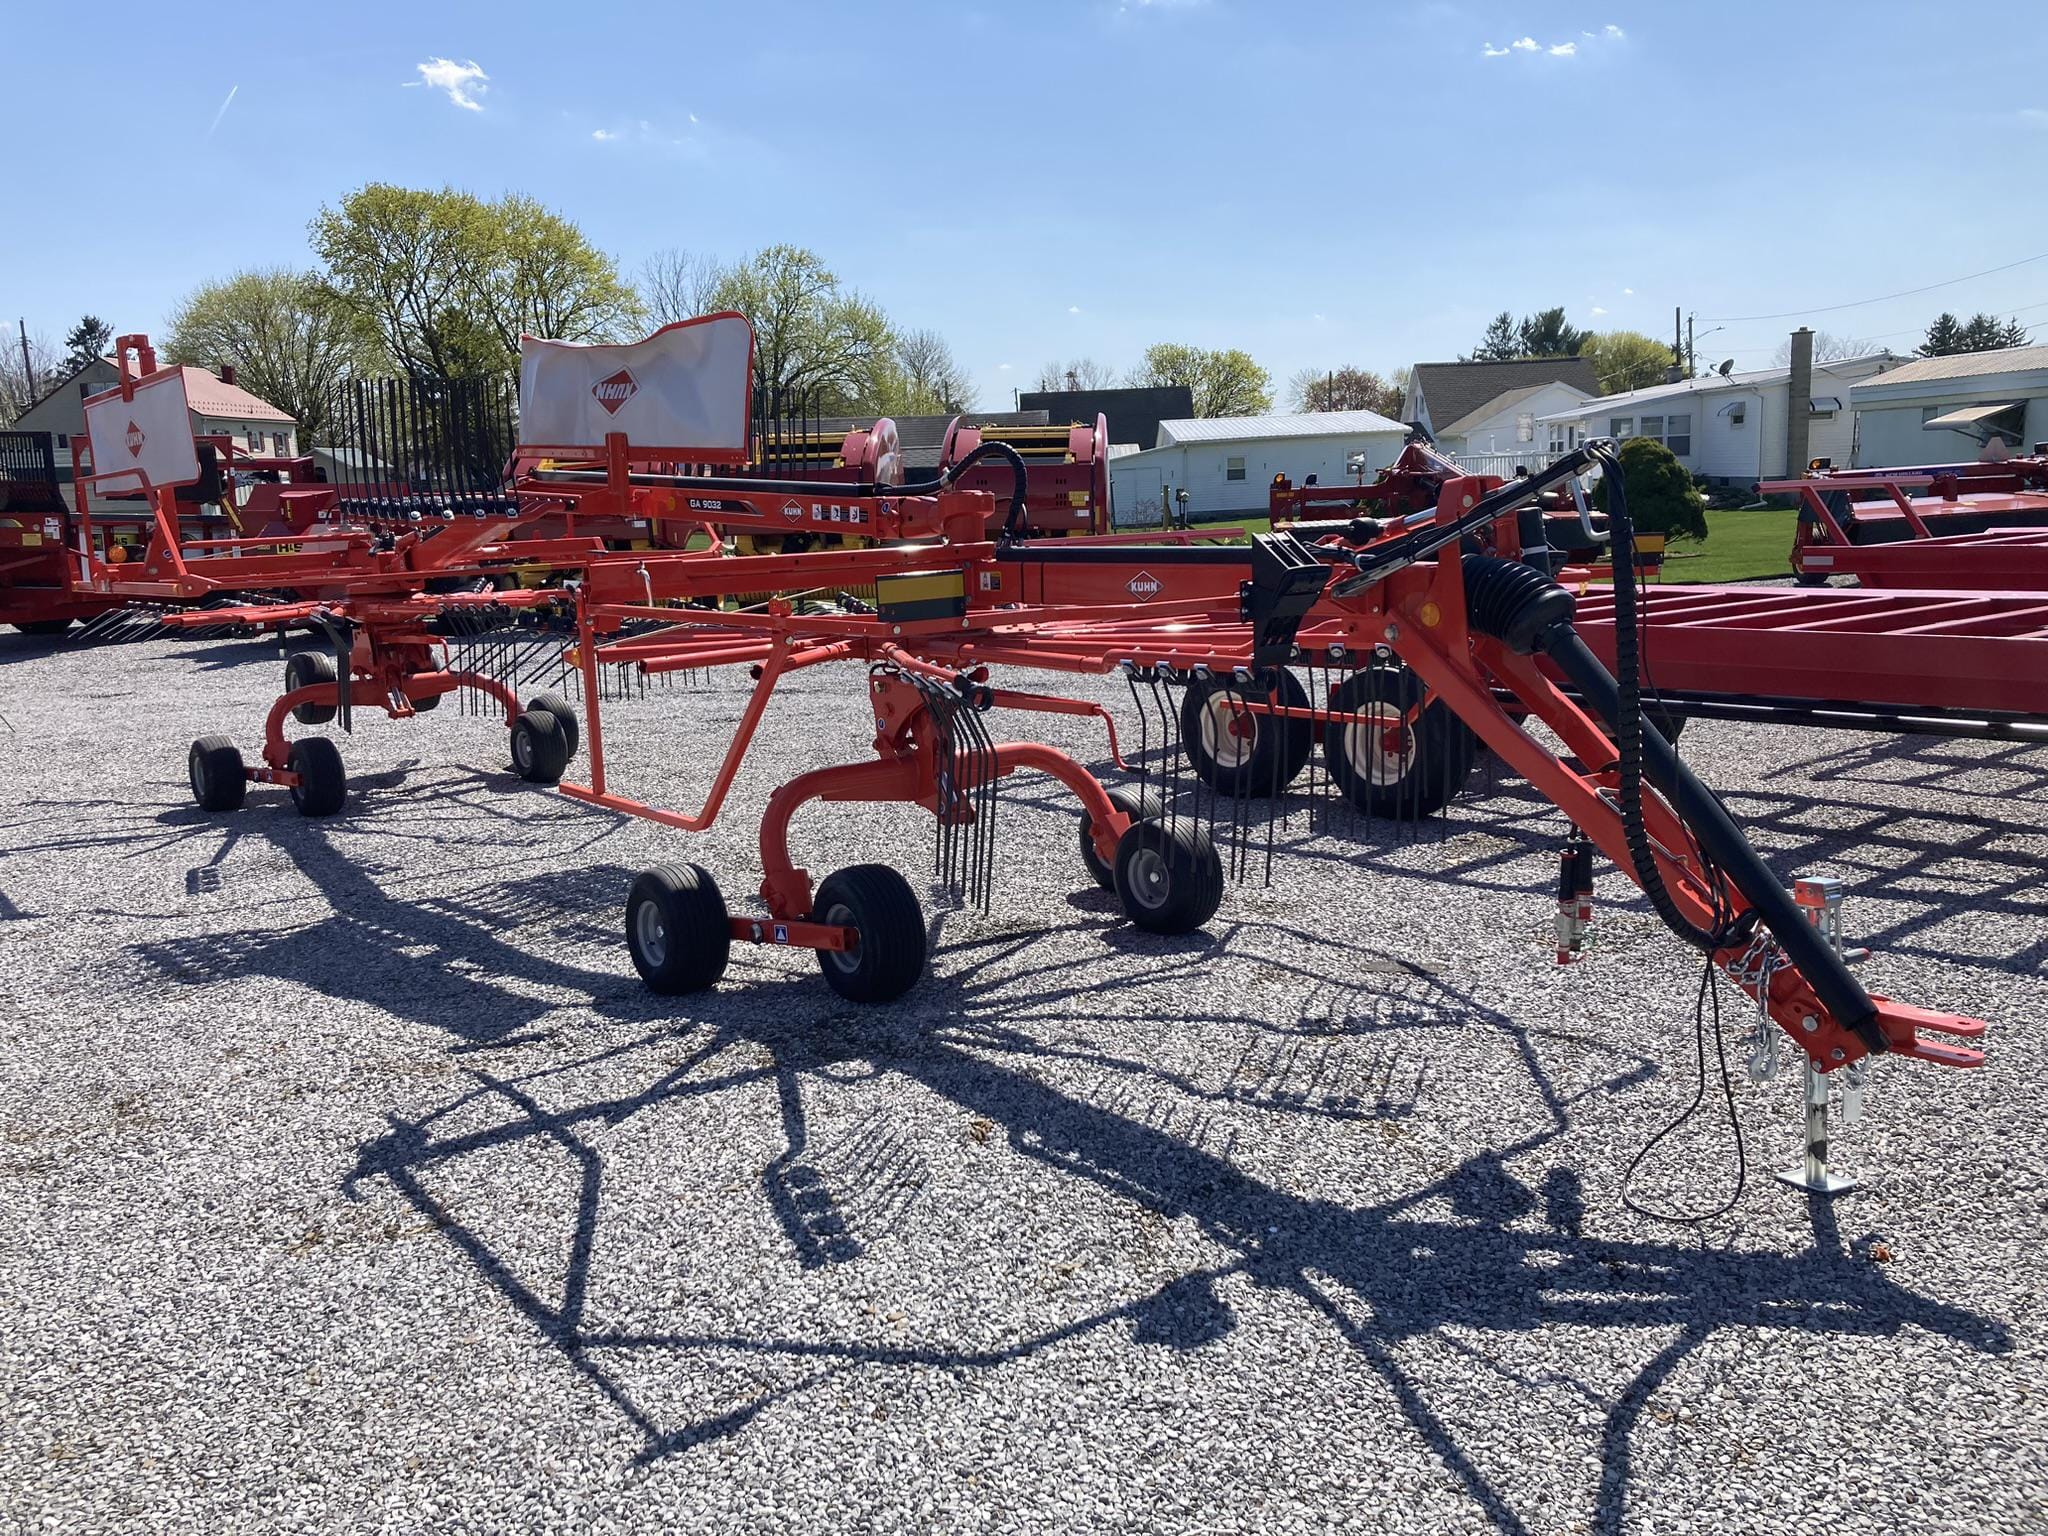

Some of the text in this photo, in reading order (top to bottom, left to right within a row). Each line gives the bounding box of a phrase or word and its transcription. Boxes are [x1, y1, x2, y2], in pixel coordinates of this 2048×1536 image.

[597, 383, 633, 400] KUHN
[690, 499, 721, 509] GA 9032
[784, 507, 802, 516] KUHN
[1131, 581, 1157, 592] KUHN
